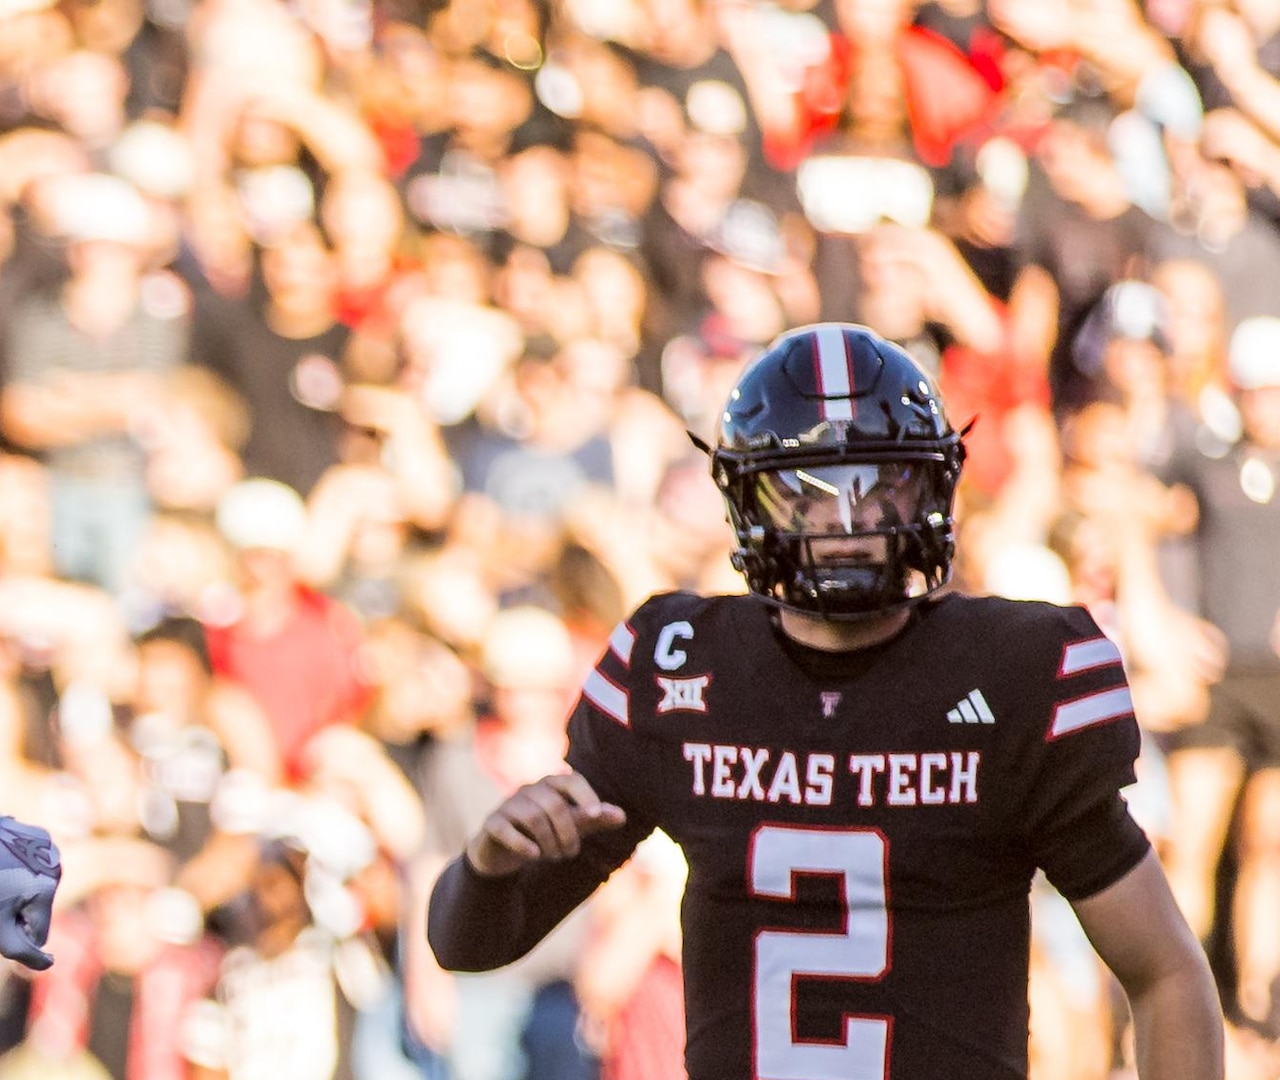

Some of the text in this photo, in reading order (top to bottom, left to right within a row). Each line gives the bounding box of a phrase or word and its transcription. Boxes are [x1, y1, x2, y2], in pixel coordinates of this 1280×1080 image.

[654, 621, 694, 671] C
[682, 742, 980, 807] TEXAS TECH
